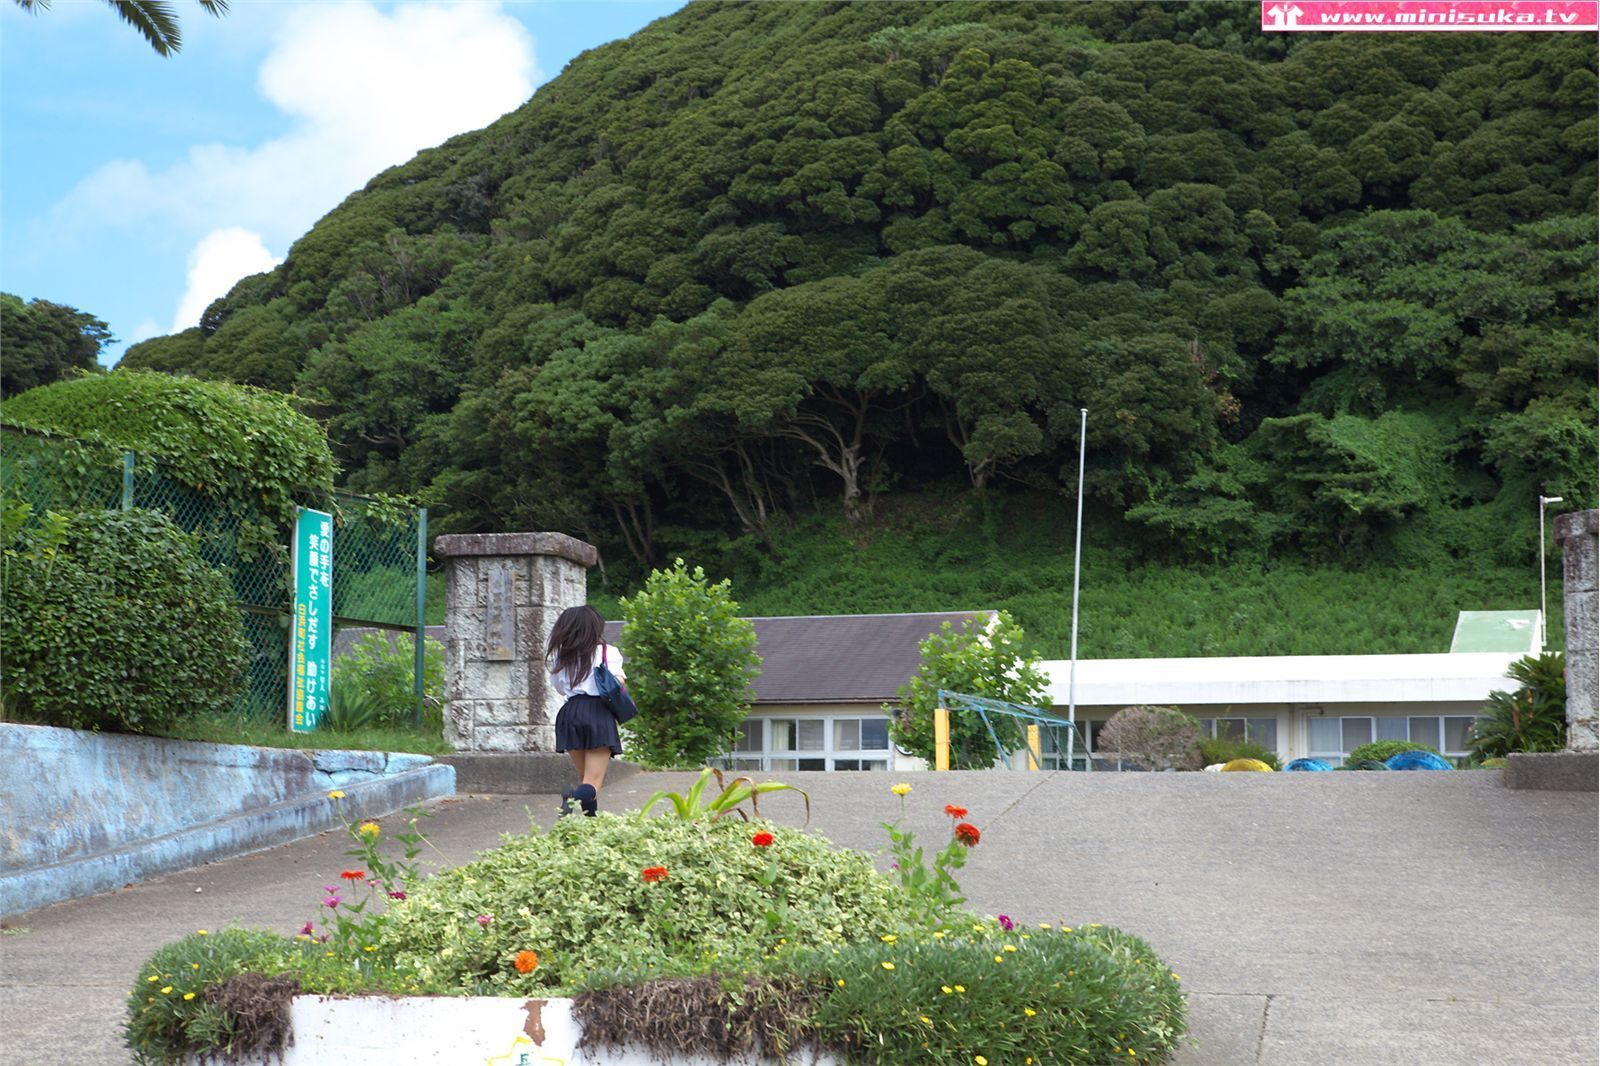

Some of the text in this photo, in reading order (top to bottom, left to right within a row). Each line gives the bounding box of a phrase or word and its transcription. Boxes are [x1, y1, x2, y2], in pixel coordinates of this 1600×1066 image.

[319, 521, 330, 588] 愛の手を
[306, 533, 319, 727] 笑顔でさしだす 助けあい
